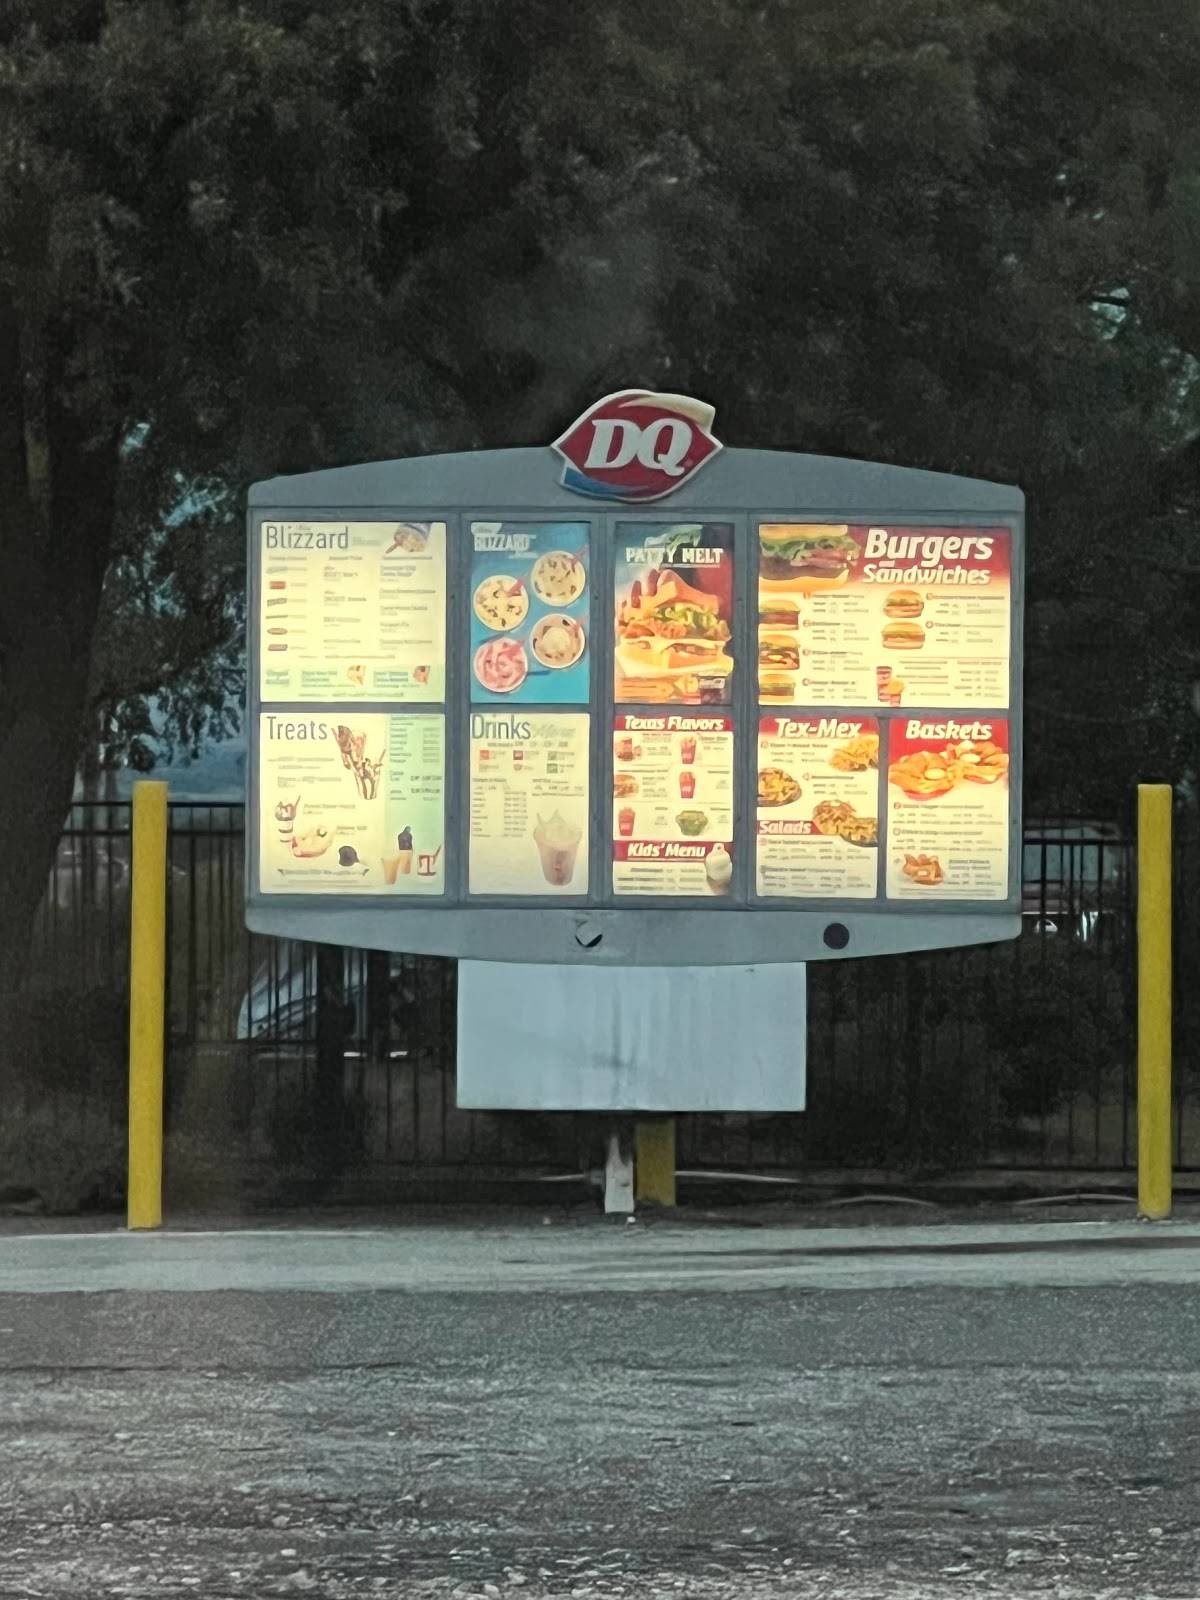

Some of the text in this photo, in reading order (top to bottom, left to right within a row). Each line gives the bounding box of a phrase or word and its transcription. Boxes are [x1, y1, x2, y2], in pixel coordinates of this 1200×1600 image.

[583, 417, 692, 476] DQ
[266, 525, 349, 549] Blizzard
[864, 528, 994, 568] Burgers
[625, 547, 724, 563] PATTY MELT
[862, 562, 991, 585] Sandwiches
[266, 716, 328, 741] Treats
[472, 714, 531, 740] Drinks
[625, 715, 724, 731] Texas Flavors
[774, 718, 862, 738] Tex-Mex
[905, 719, 993, 740] Baskets
[758, 820, 812, 834] Salads
[628, 842, 706, 858] Kids' Menu
